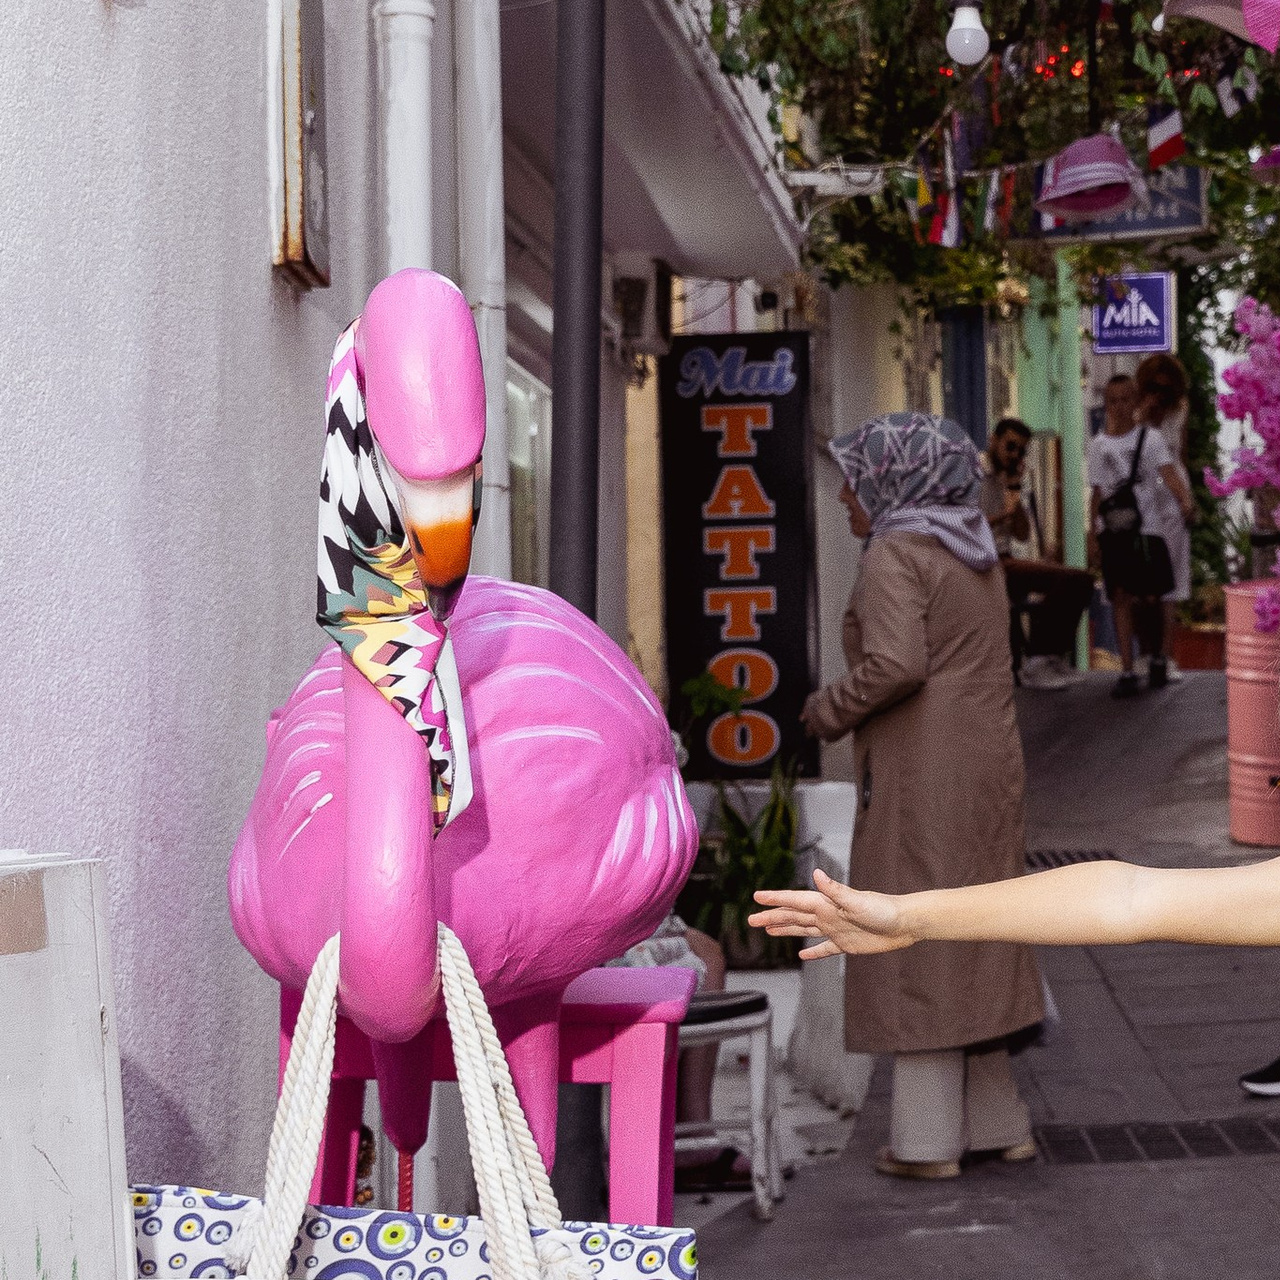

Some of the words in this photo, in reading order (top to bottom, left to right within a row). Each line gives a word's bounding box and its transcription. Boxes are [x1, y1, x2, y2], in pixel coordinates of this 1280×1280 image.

[1102, 287, 1161, 328] MIA
[676, 346, 798, 399] Mai
[700, 403, 781, 766] TATTOO
